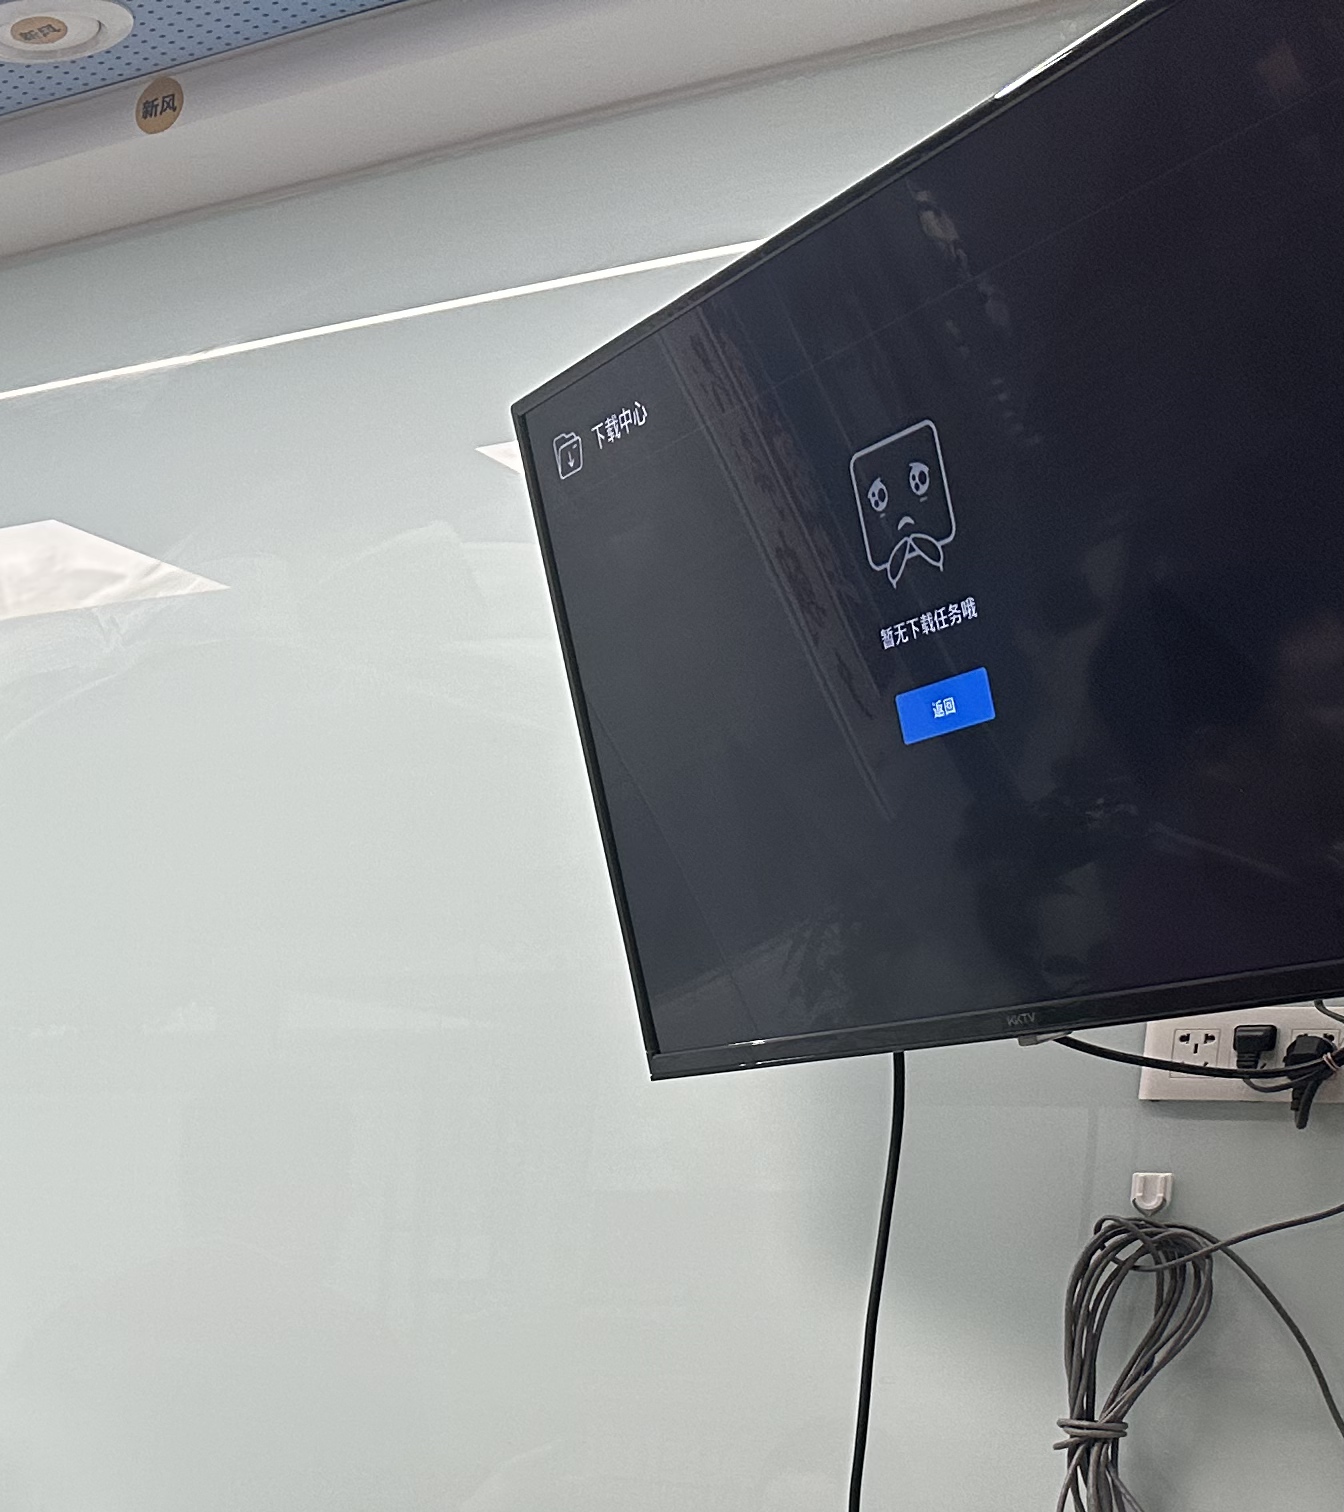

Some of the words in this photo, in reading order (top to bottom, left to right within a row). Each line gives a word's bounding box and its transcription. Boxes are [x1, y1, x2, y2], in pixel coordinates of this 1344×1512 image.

[19, 23, 62, 41] 新风
[141, 93, 177, 120] 新风
[591, 401, 648, 450] 下载中心
[880, 596, 978, 650] 暂无下载任务哦
[932, 697, 957, 718] 返回
